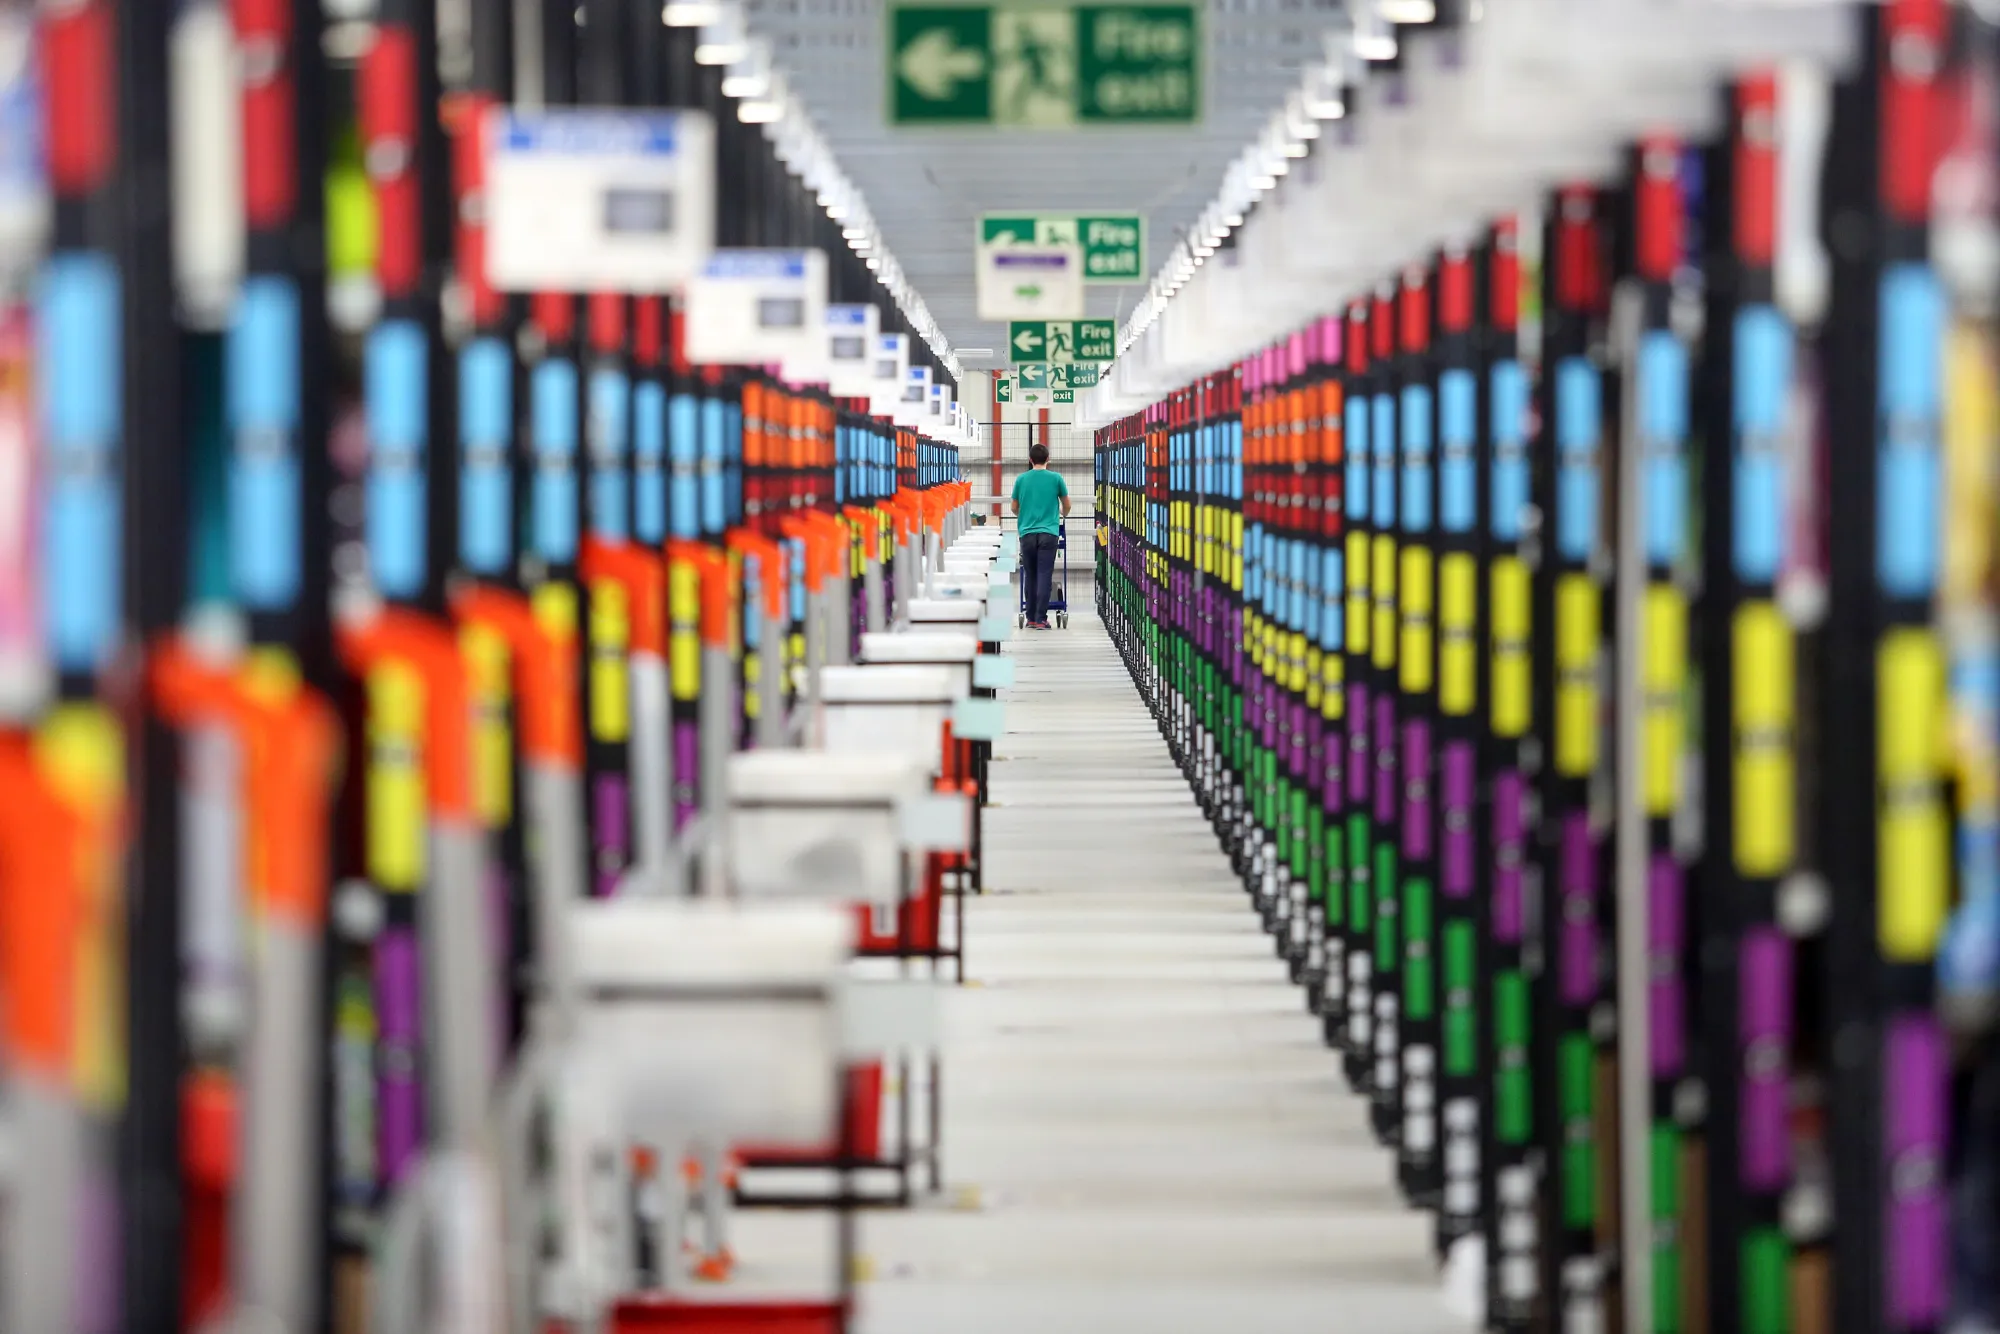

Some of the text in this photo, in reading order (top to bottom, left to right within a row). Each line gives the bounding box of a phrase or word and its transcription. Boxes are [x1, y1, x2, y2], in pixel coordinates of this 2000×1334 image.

[1094, 13, 1191, 60] Fire
[1096, 70, 1190, 114] exit
[1088, 221, 1137, 247] Fire
[1089, 250, 1137, 273] exit
[1081, 324, 1111, 339] Fire
[1081, 343, 1112, 357] exit
[1073, 362, 1095, 372] Fire
[1073, 374, 1096, 384] exit
[1053, 391, 1072, 400] exit
